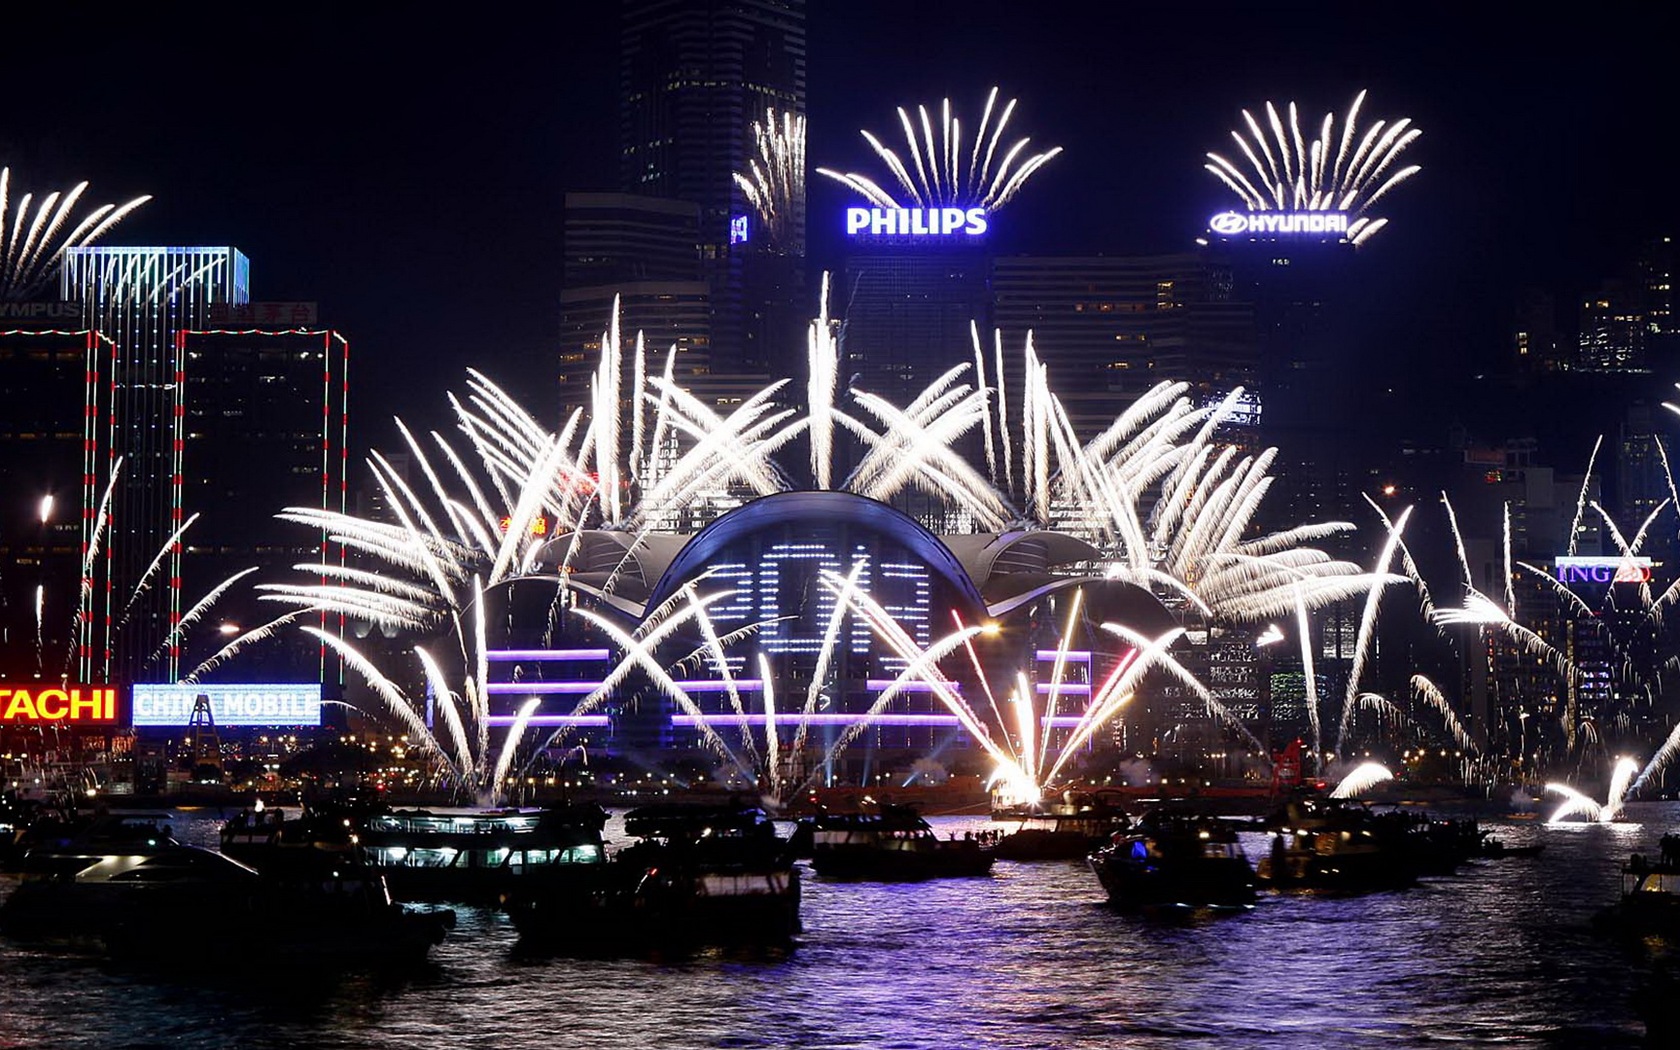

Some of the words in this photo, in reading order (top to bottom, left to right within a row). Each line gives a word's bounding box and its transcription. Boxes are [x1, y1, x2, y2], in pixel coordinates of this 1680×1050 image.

[847, 208, 987, 234] PHILIPS
[1249, 215, 1347, 232] HYUNDAI
[1557, 565, 1611, 582] ING
[223, 693, 319, 716] MOBILE
